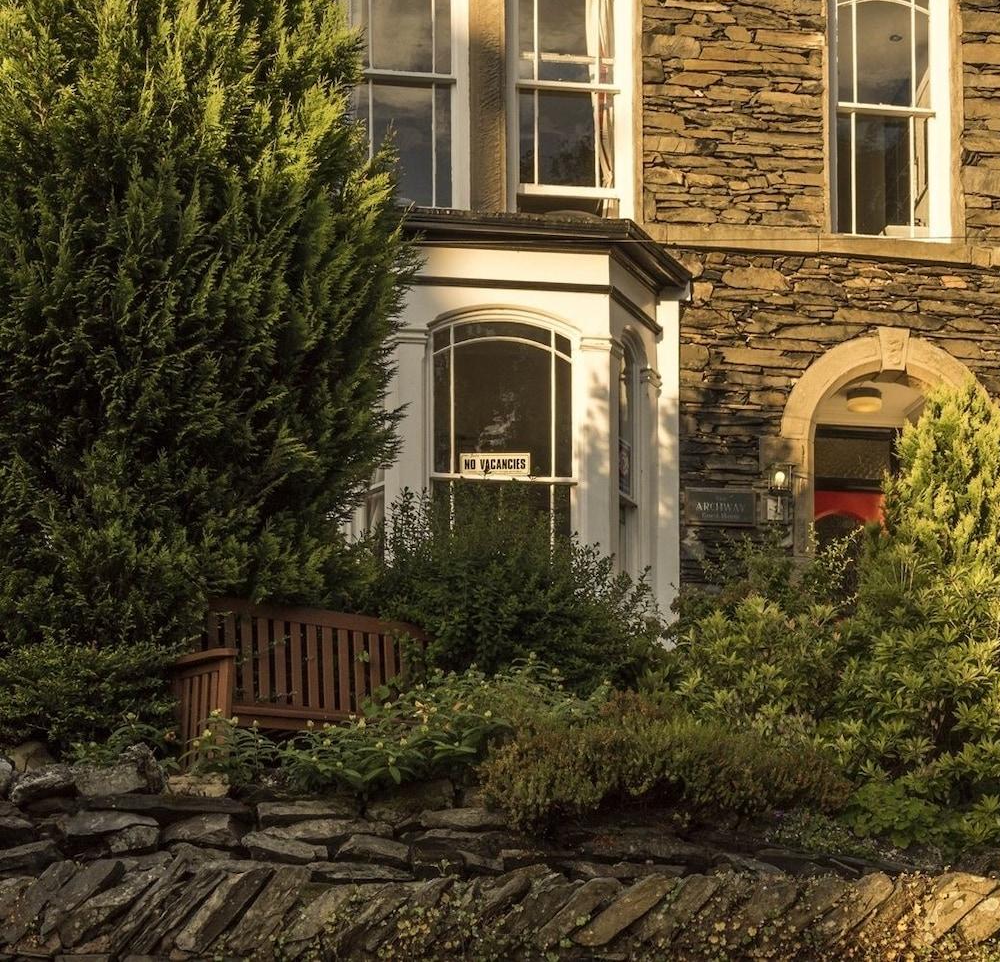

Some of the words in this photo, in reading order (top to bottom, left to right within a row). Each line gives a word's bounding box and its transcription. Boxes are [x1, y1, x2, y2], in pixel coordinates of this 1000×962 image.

[464, 458, 476, 470] NO
[479, 458, 526, 470] VACANCIES
[696, 502, 744, 512] ARCHWAY
